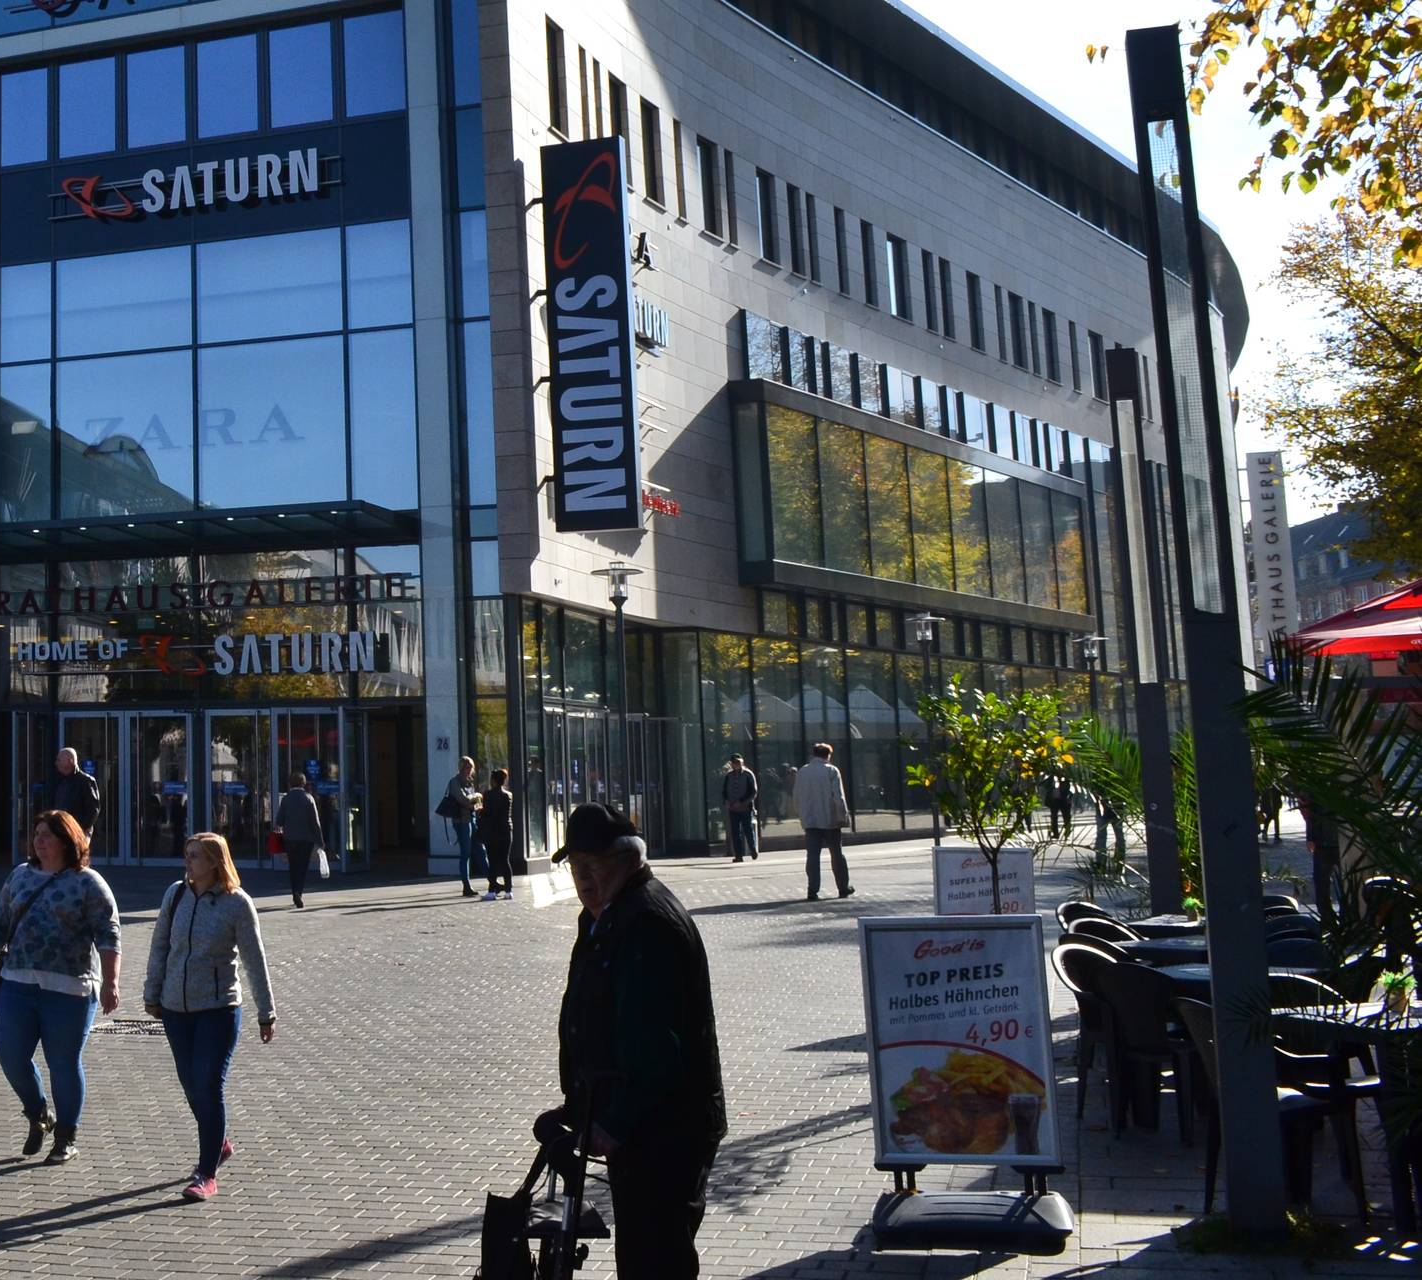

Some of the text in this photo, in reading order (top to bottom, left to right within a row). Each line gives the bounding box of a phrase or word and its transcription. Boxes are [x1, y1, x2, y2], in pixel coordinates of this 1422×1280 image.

[141, 147, 319, 213] SATURN
[555, 274, 627, 512] SATURN
[85, 403, 306, 450] ZARA
[1258, 457, 1287, 639] ATHAUS GALERIE
[208, 573, 412, 609] GALERIE
[17, 630, 375, 675] HOME OF SATURN
[947, 891, 976, 901] Halbes
[904, 963, 1004, 988] TOP PREIS
[889, 984, 1019, 1010] Halbes Hähnchen
[889, 1015, 905, 1025] mit
[908, 1012, 946, 1024] Pommes
[948, 1008, 966, 1019] und
[983, 1001, 1019, 1015] Getränk
[965, 1018, 1034, 1047] 4,90 €
